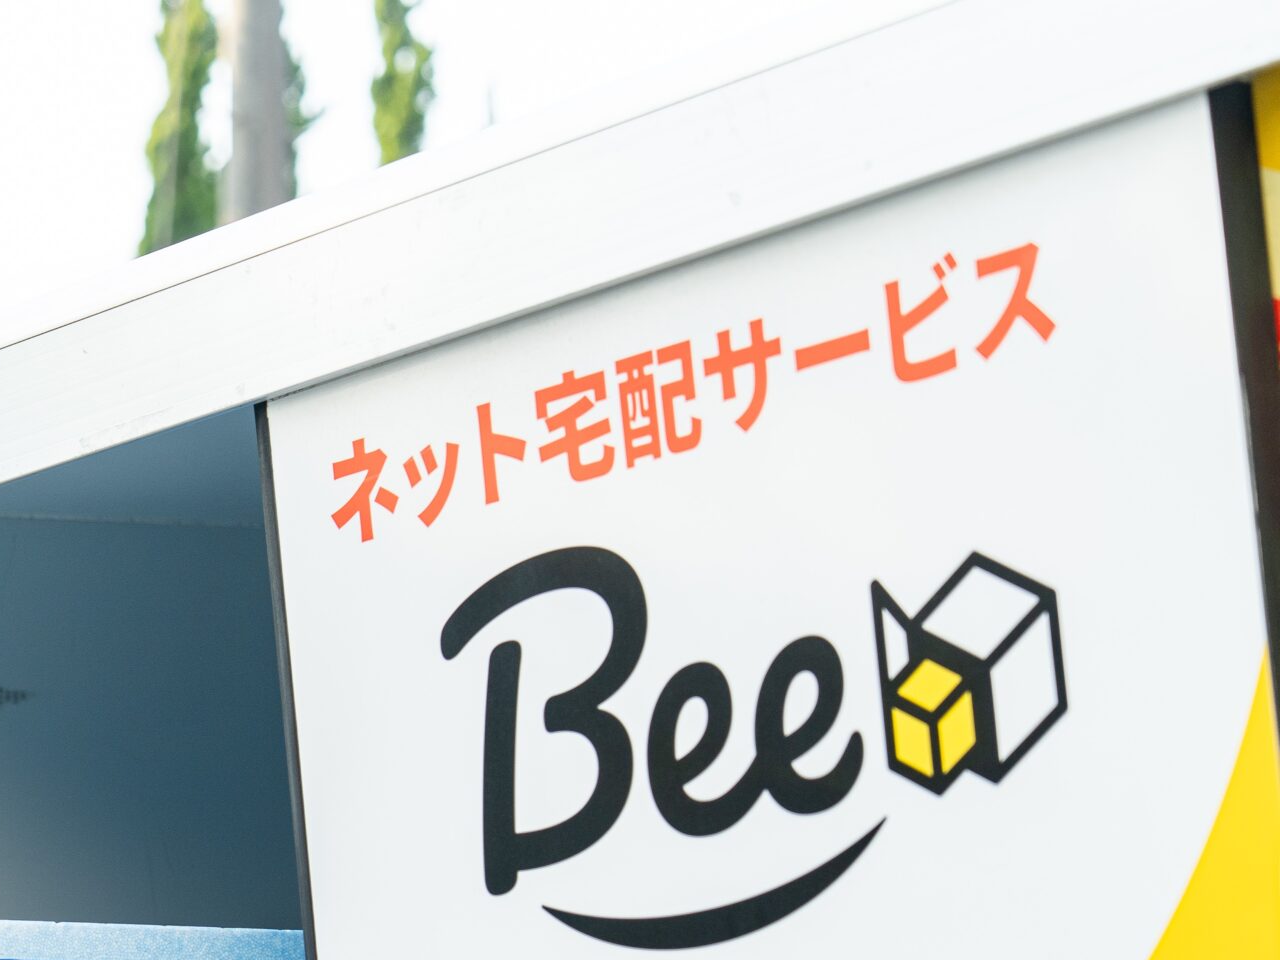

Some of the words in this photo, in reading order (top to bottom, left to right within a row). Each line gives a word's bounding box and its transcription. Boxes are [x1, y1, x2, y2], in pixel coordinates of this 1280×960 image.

[330, 242, 1057, 543] ネット宅配サービス
[440, 545, 865, 896] Bee
